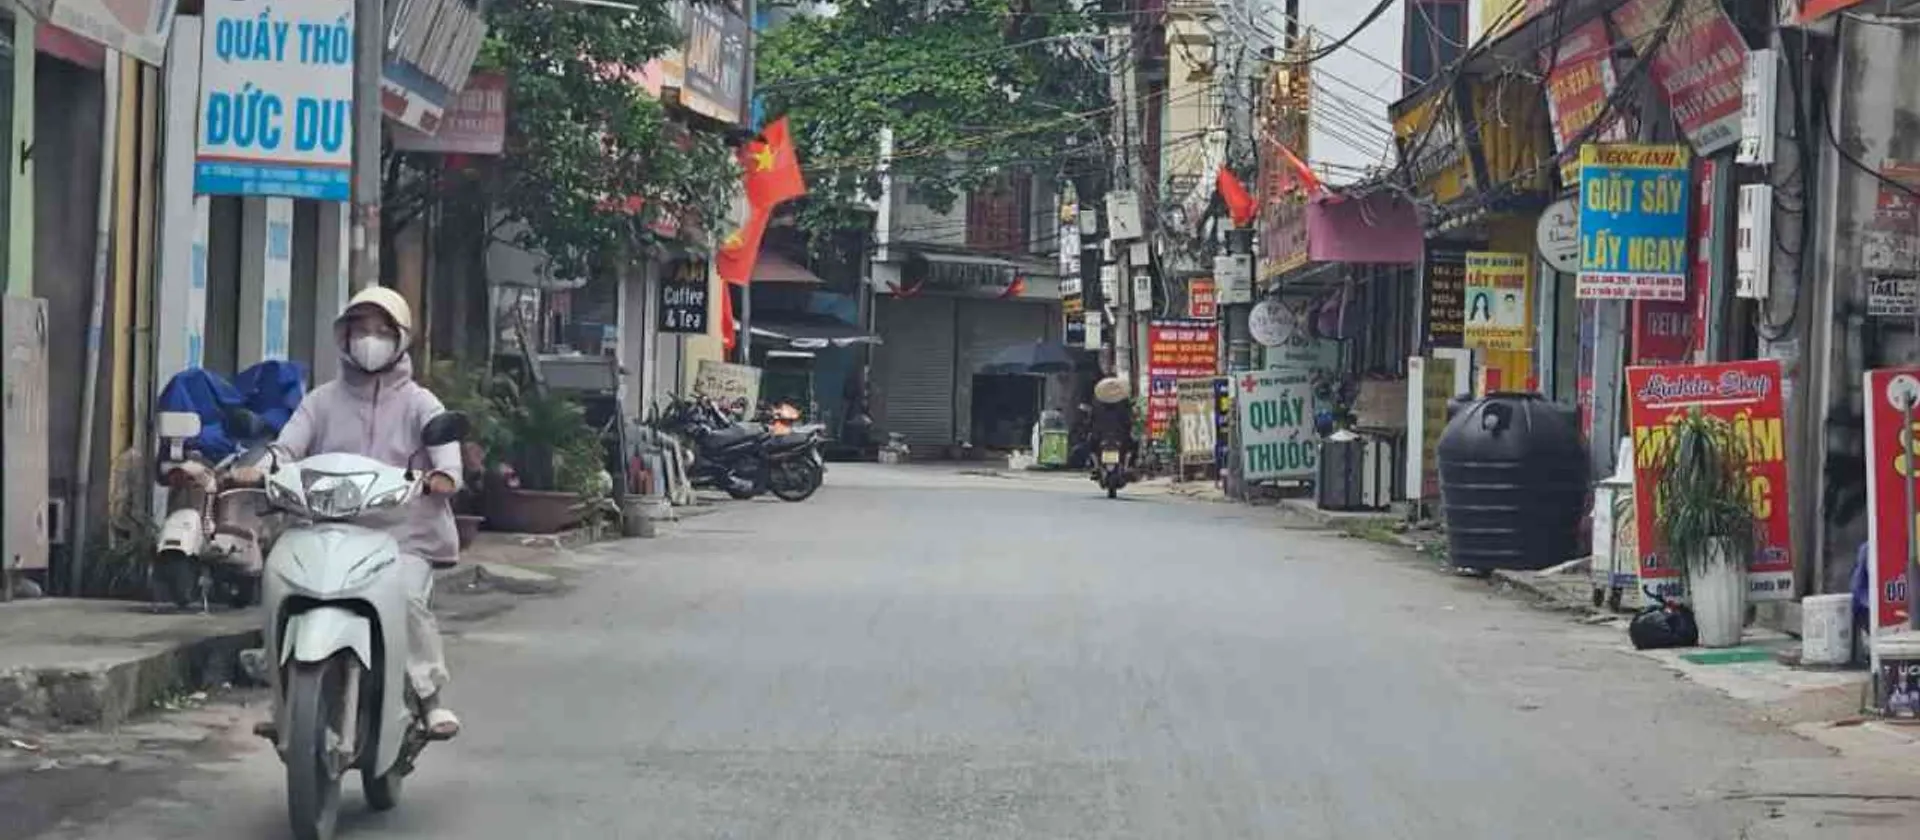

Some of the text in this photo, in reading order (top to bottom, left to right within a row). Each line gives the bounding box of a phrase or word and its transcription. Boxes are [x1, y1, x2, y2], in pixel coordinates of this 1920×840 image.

[298, 12, 353, 65] THỐ
[207, 81, 283, 150] ĐỨC
[295, 97, 352, 152] DU
[1587, 172, 1683, 219] GIẶT SẤY
[1582, 228, 1621, 271] LẤY
[663, 286, 705, 306] Coffee
[665, 310, 702, 328] & Tea
[1246, 429, 1315, 473] THUỐC
